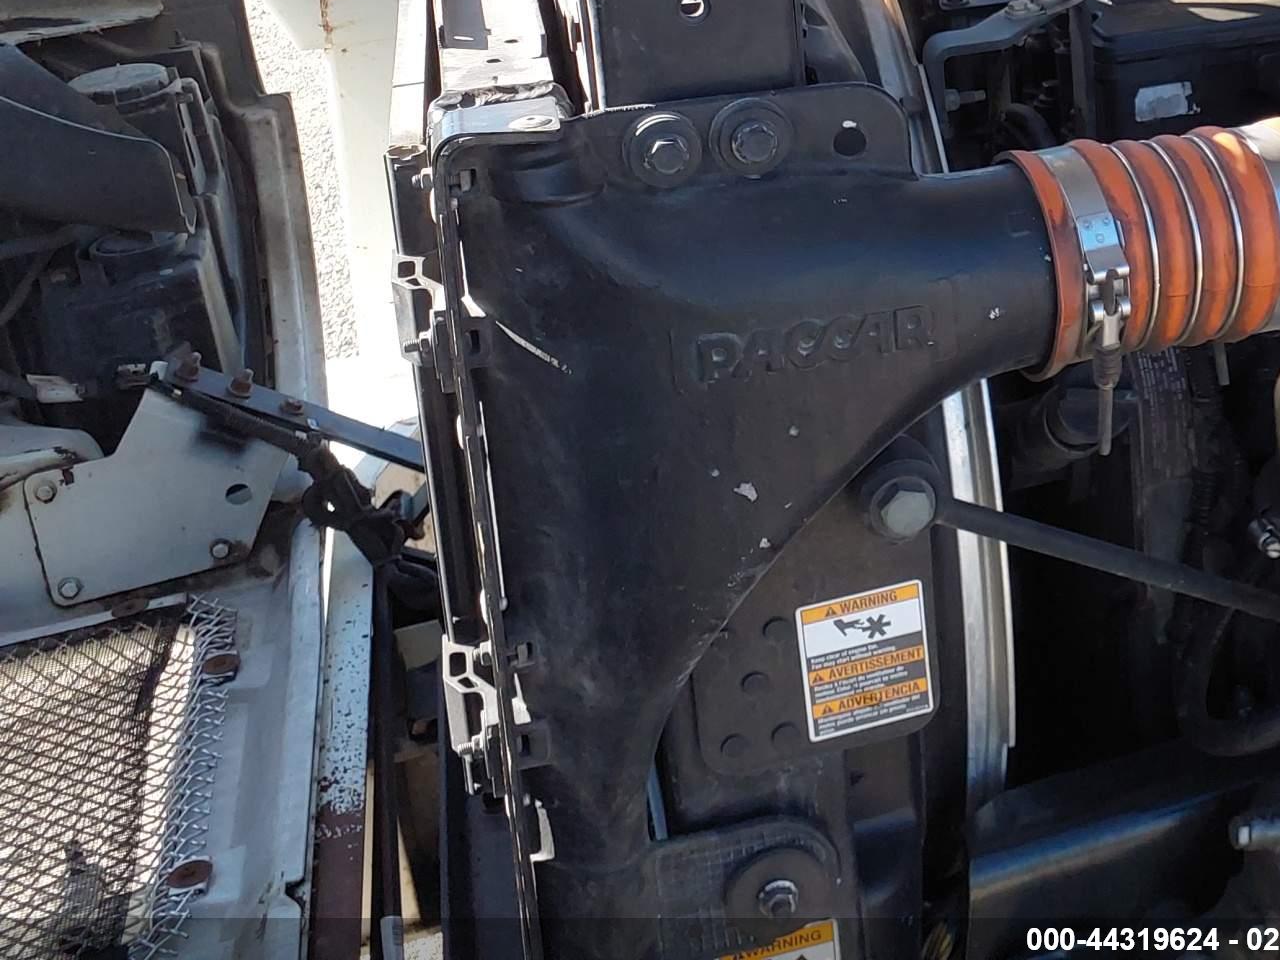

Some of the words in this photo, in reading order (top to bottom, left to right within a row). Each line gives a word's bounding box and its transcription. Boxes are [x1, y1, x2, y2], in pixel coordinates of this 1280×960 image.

[697, 304, 935, 383] PACCAR
[839, 590, 898, 614] WARNING
[829, 646, 922, 680] AVERTISSEMENT
[838, 682, 920, 711] ADVERTENCIA
